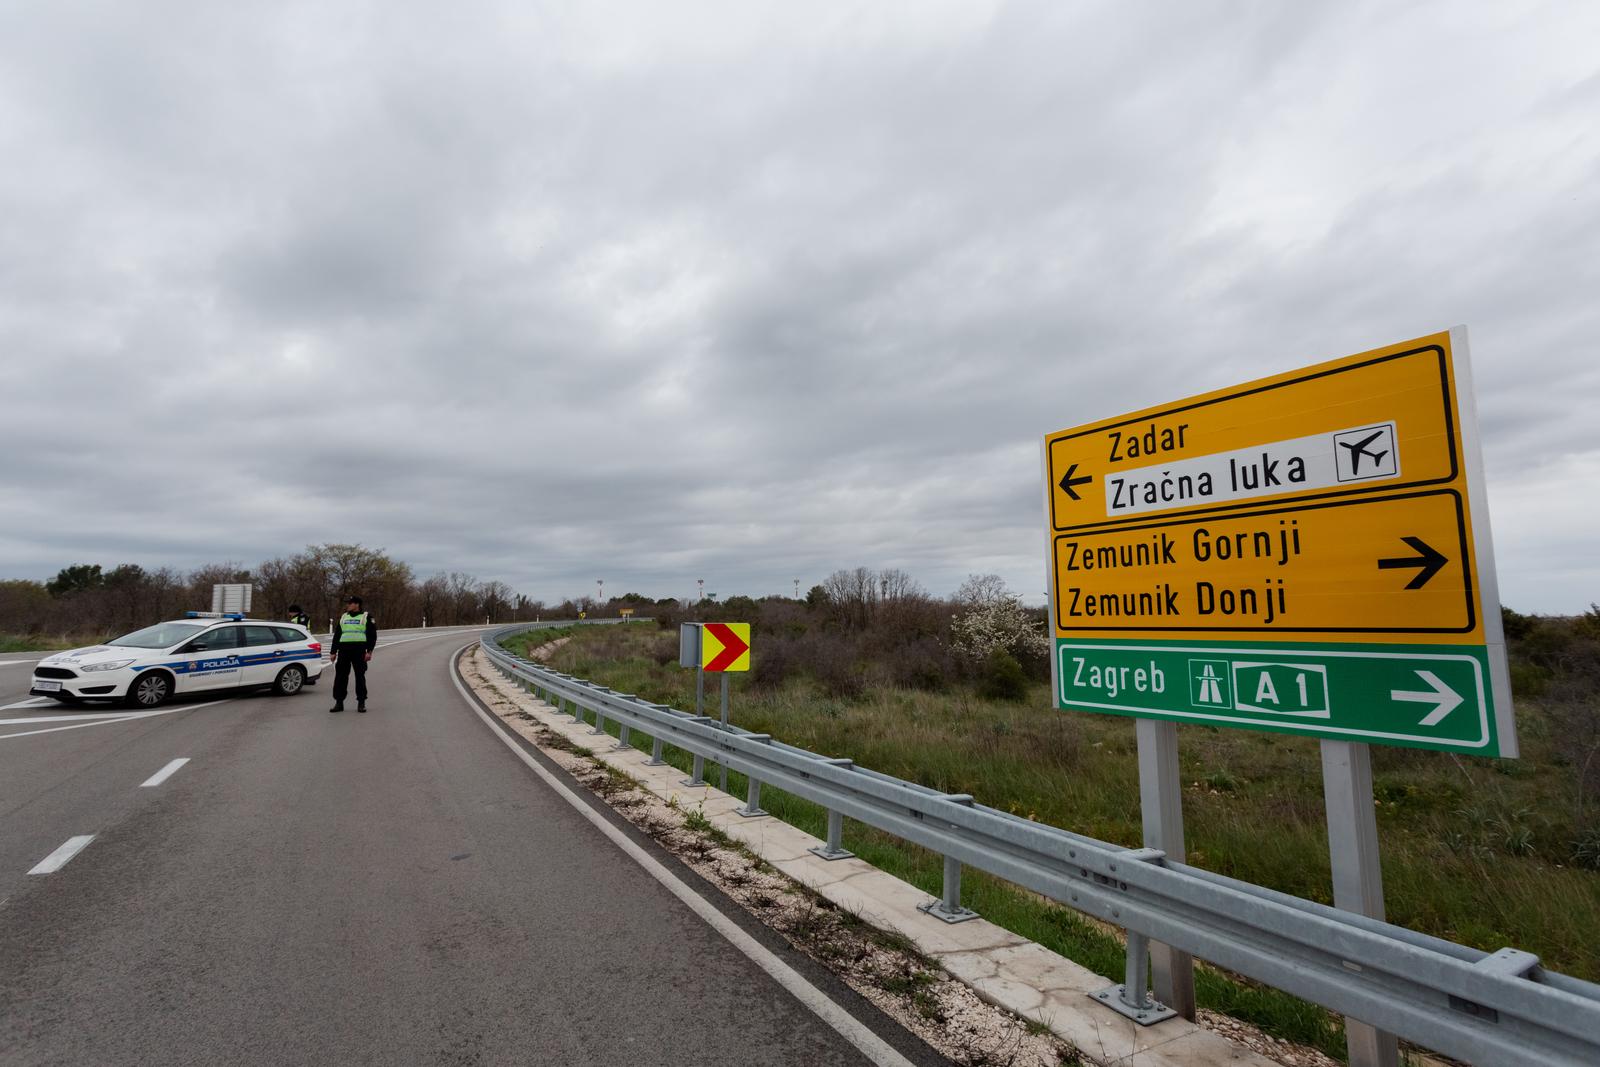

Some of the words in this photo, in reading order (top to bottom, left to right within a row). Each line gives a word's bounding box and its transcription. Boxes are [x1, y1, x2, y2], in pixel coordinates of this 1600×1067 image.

[1108, 423, 1189, 462] Zadar
[1111, 471, 1213, 509] Zračna
[1230, 452, 1306, 492] luka
[1066, 533, 1177, 571] Zemunik
[1193, 519, 1301, 566] Gornji
[1068, 583, 1180, 617] Zemunik
[1196, 578, 1286, 624] Donji
[202, 659, 240, 669] POLICIJA
[1072, 657, 1166, 698] Zagreb
[1255, 671, 1280, 704] A
[1295, 672, 1308, 707] 1
